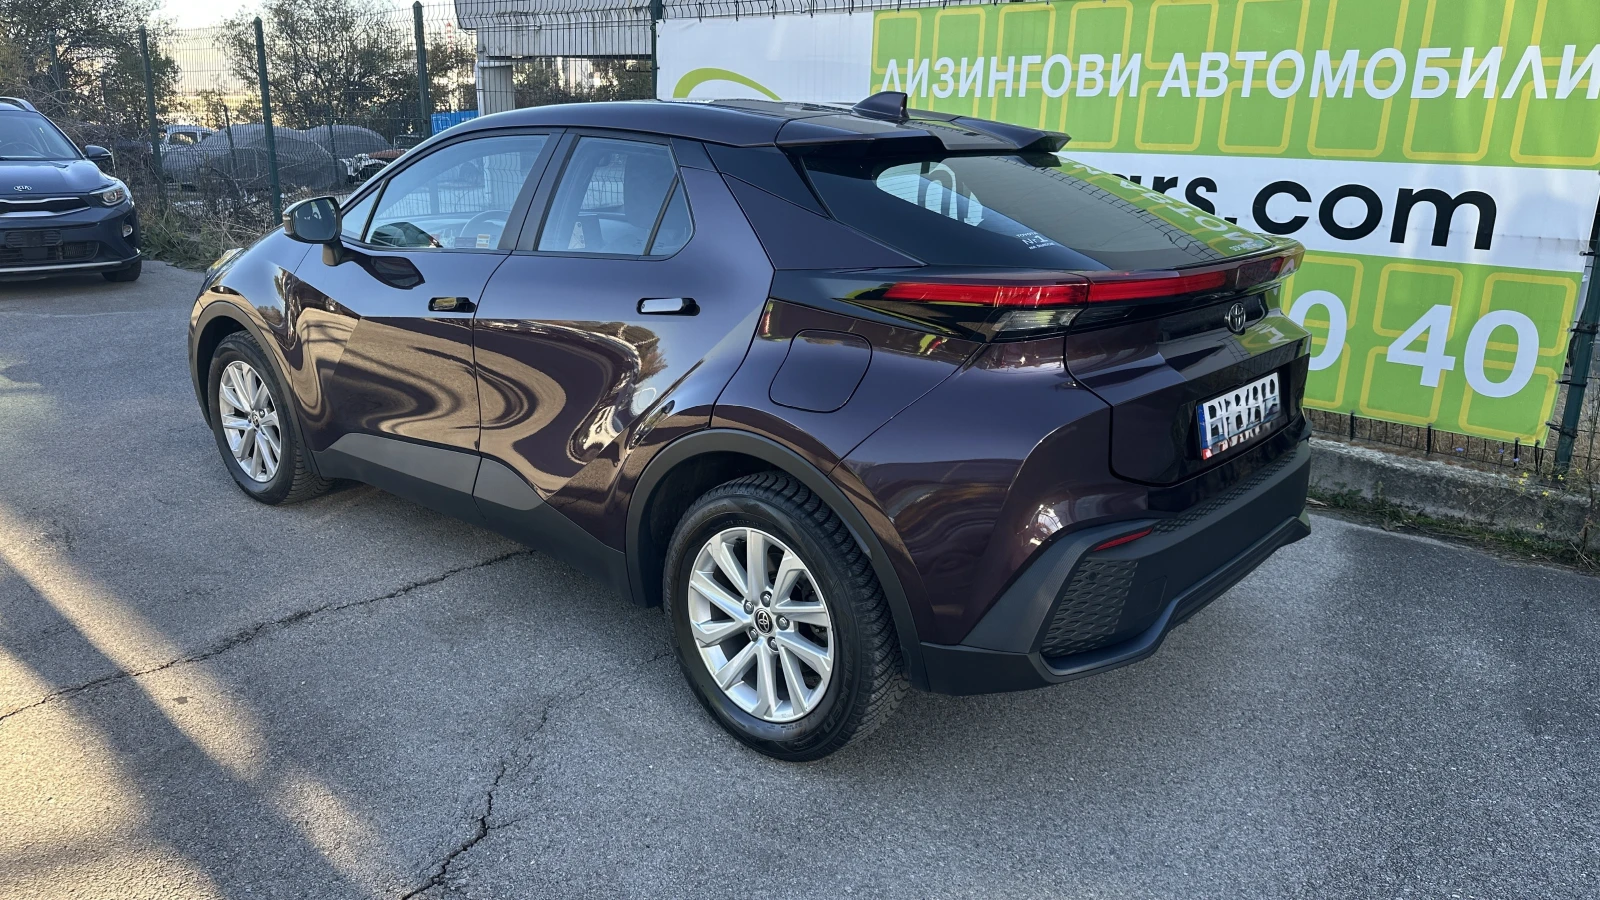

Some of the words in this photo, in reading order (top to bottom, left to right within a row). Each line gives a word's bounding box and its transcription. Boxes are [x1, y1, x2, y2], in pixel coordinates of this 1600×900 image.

[881, 53, 1142, 99] ЛИЗИНГОВИ
[1157, 44, 1600, 100] АВТОМОБИЛИ
[1386, 304, 1540, 398] 40
